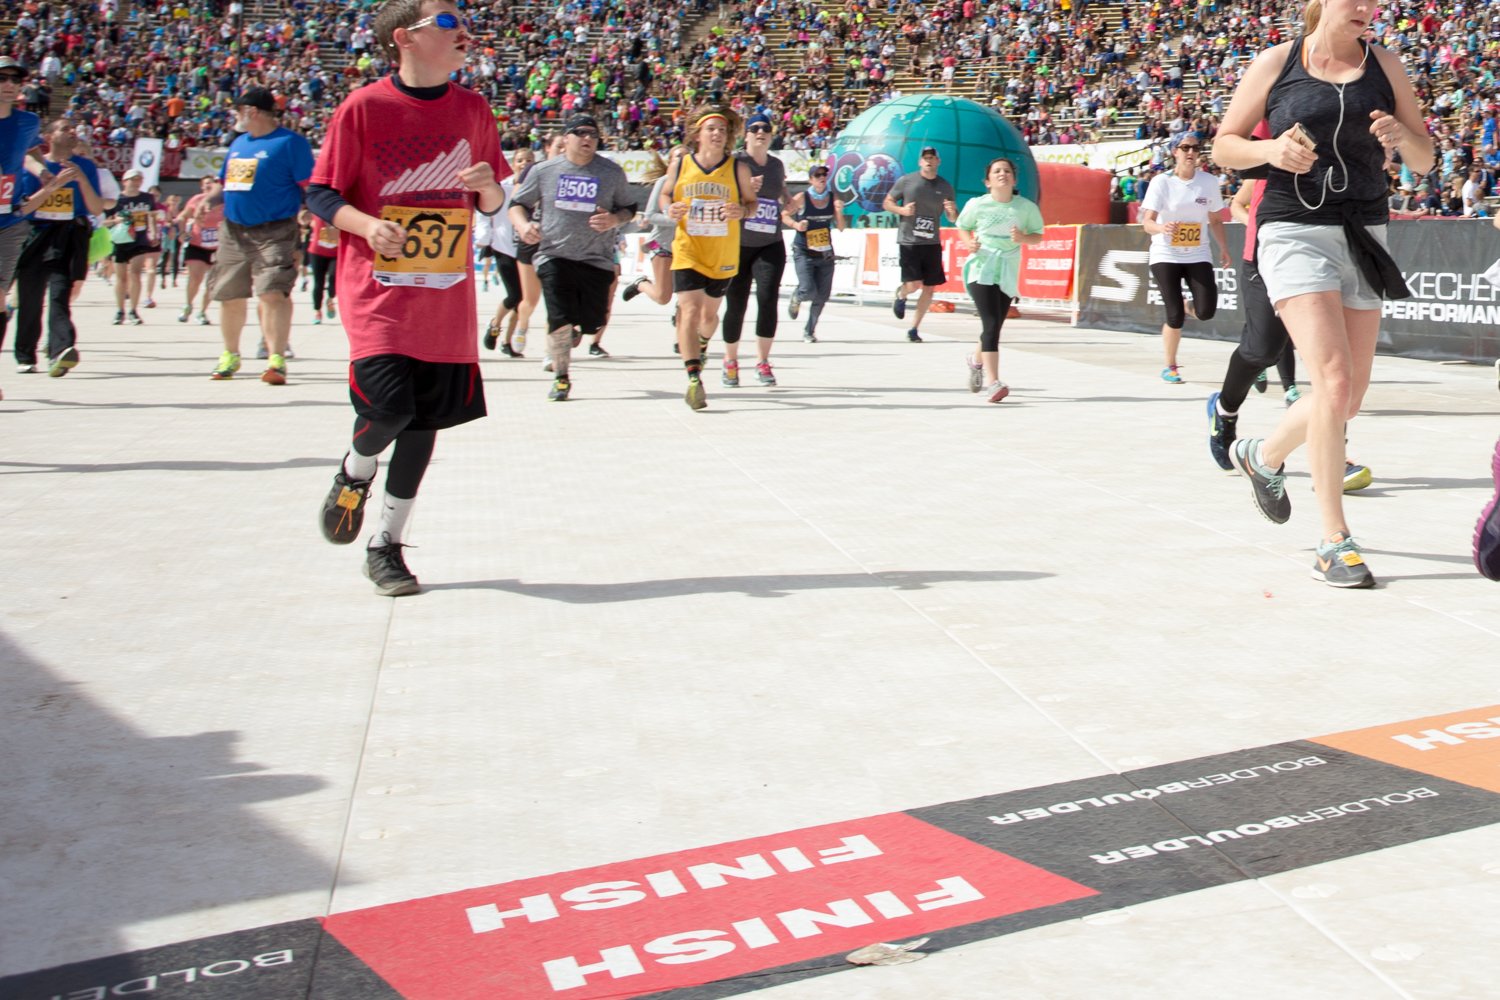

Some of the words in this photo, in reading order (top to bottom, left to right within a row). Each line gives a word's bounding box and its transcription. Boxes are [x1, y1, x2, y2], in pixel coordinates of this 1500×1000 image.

[567, 181, 598, 198] 503
[682, 182, 732, 200] CALIFORNIA
[1117, 149, 1151, 164] croc
[986, 755, 1328, 826] BOLDERBOULDER
[1088, 787, 1440, 865] BOLDERBOULDER
[465, 834, 884, 934] FINISH
[542, 876, 985, 991] FINISH
